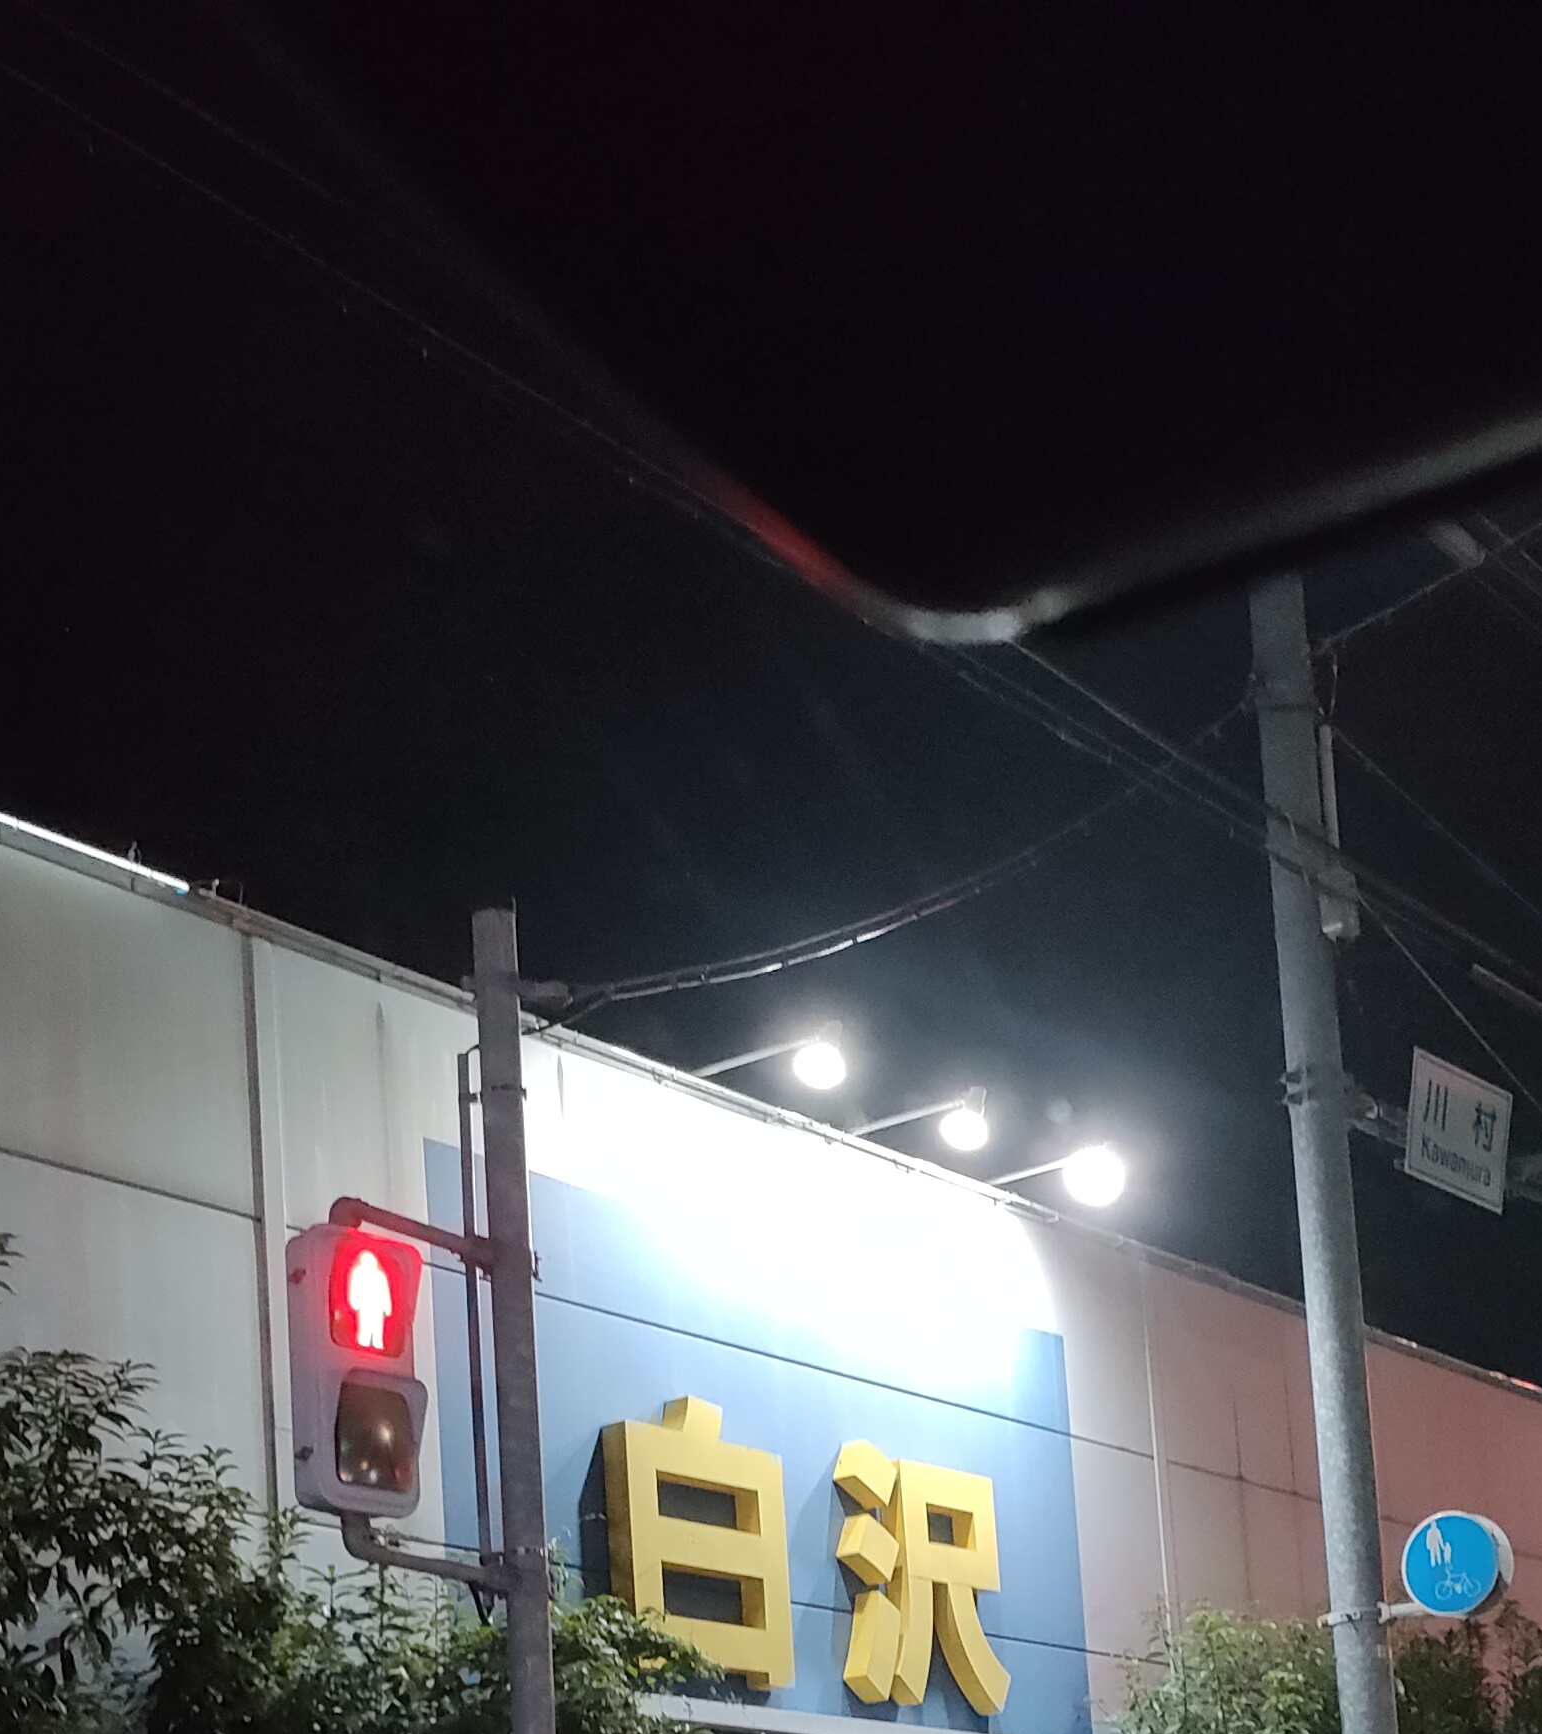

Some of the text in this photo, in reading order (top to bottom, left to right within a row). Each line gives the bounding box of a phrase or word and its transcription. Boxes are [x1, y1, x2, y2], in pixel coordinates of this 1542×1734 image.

[1422, 1079, 1497, 1153] 川村
[1421, 1132, 1491, 1187] Kawamura
[602, 1395, 1012, 1716] 白沢
